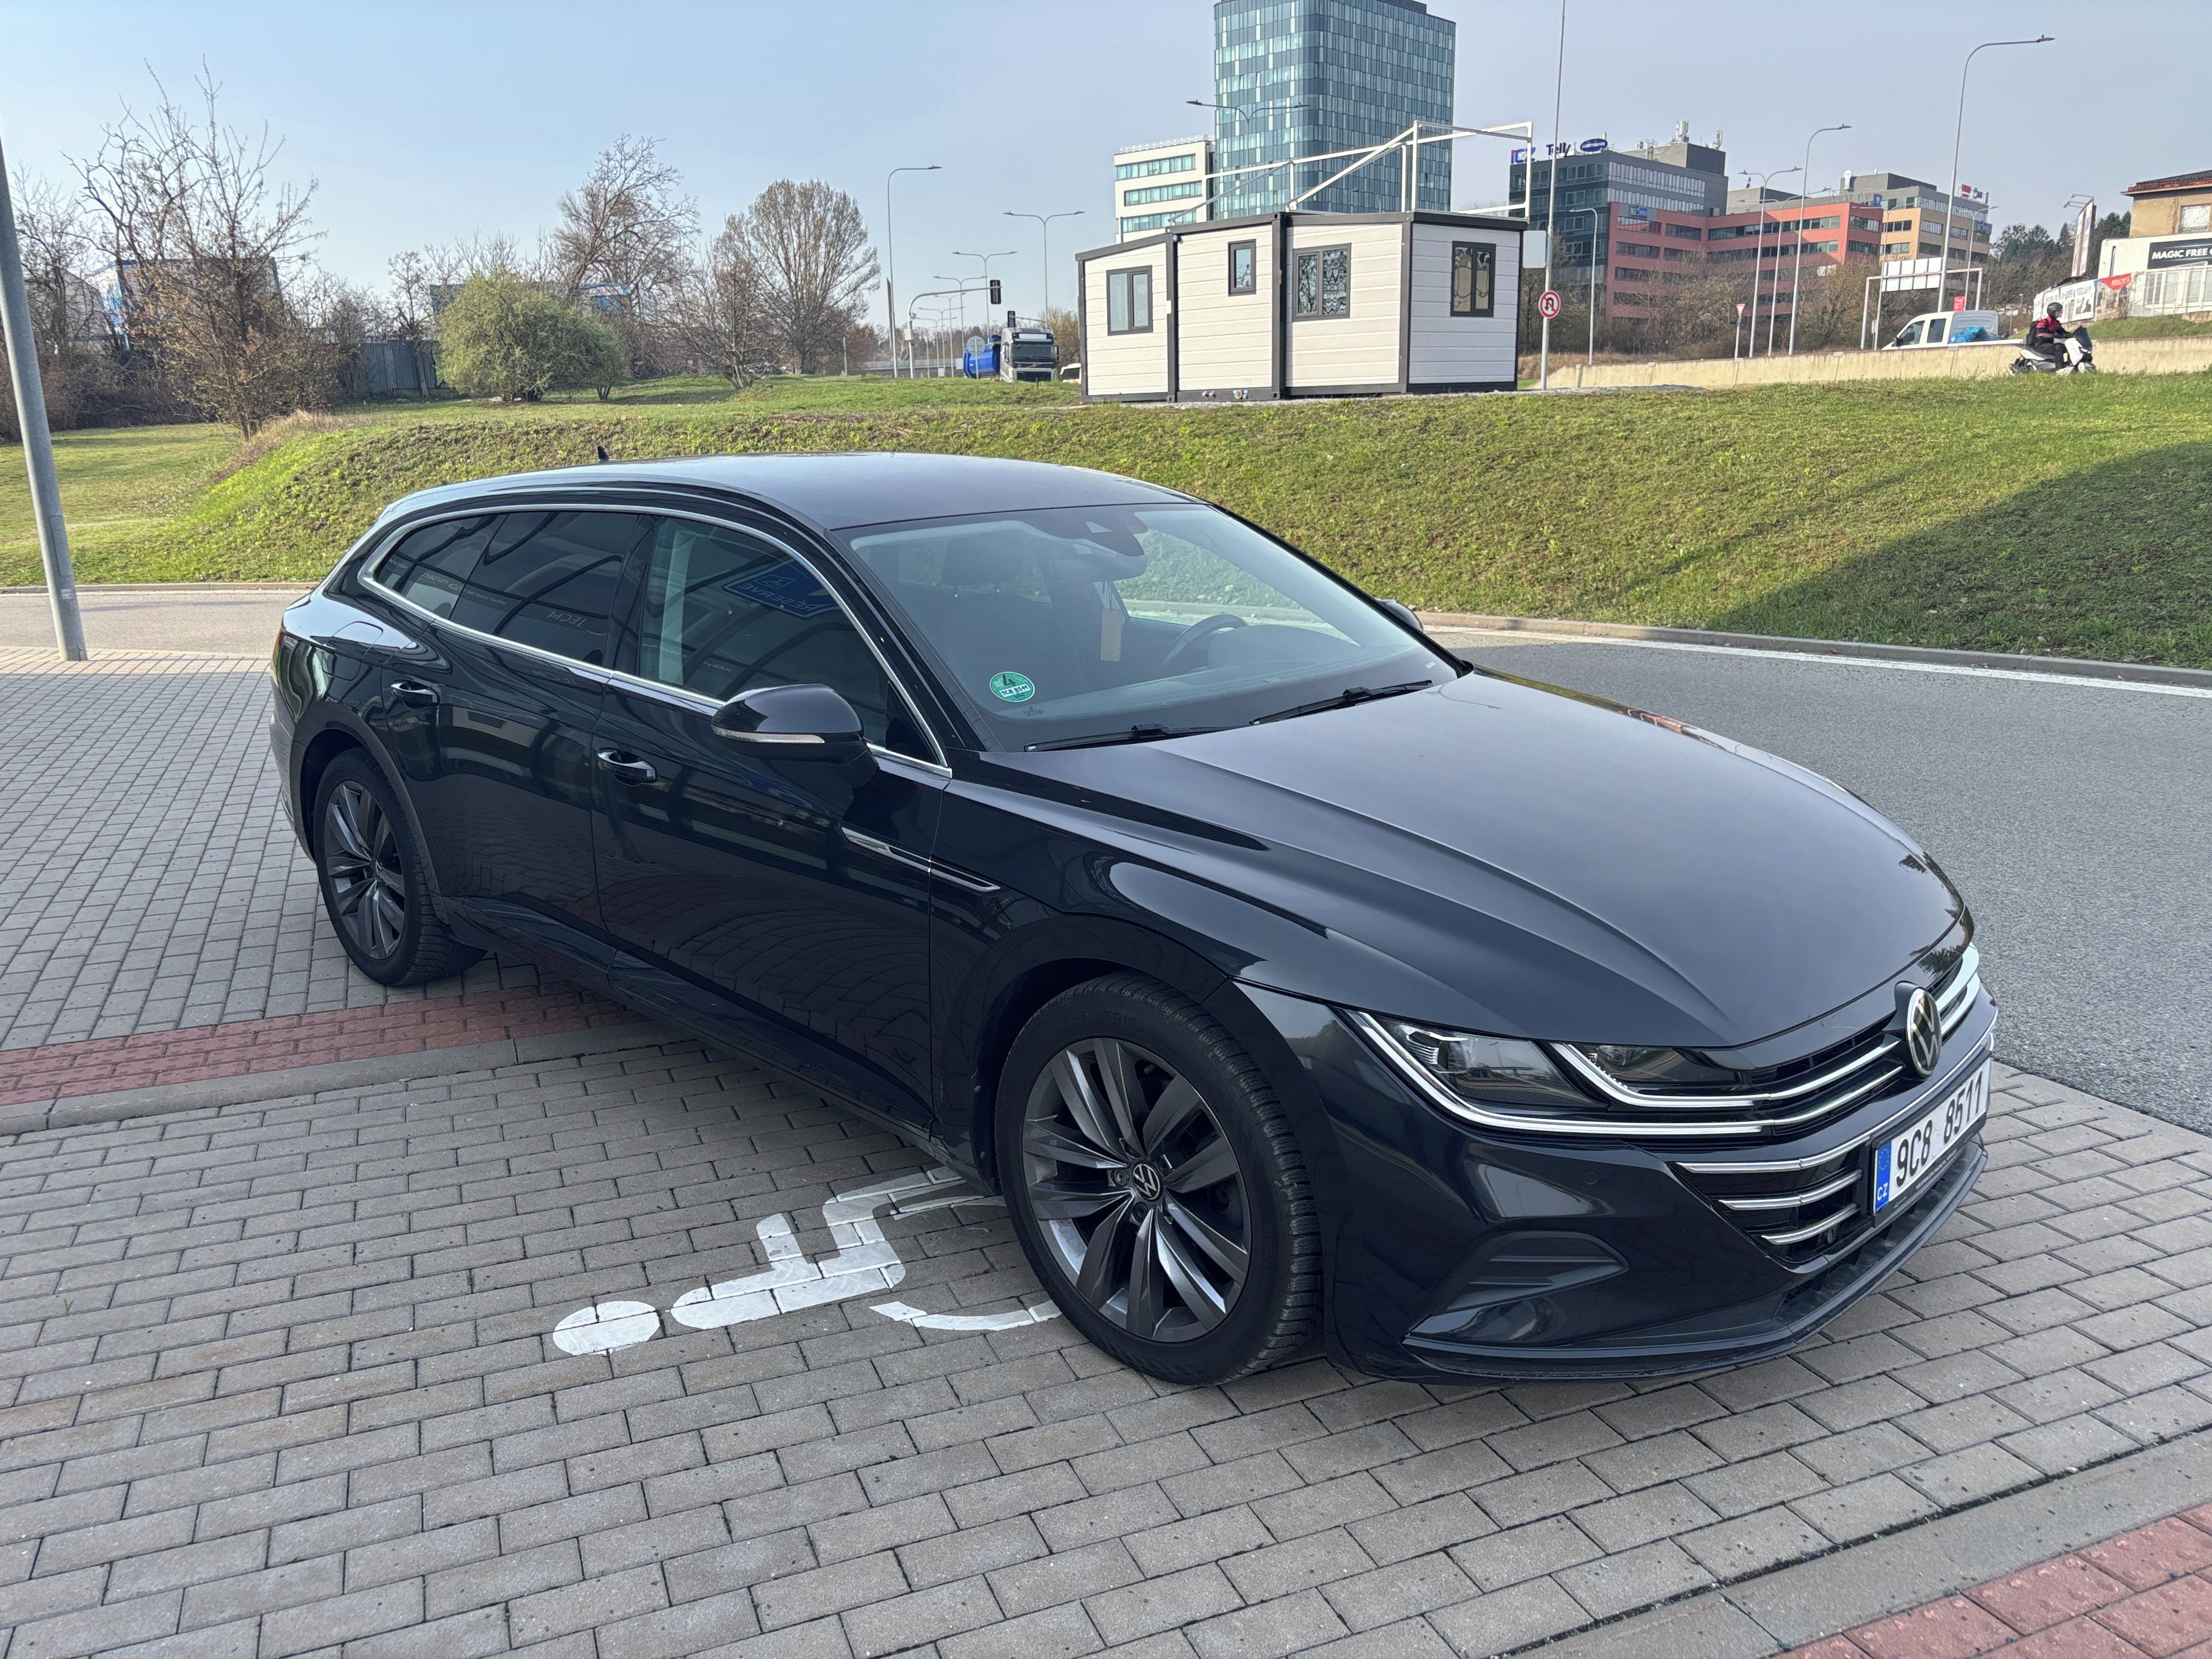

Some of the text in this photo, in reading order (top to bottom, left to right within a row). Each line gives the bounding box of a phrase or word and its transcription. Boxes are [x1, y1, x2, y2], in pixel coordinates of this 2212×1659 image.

[2152, 250, 2184, 259] MAGIC
[2185, 248, 2208, 257] FREE
[1003, 674, 1015, 686] 4
[1897, 1119, 1932, 1187] 9C8
[1944, 1069, 1983, 1144] 8511
[1877, 1182, 1888, 1201] CZ
